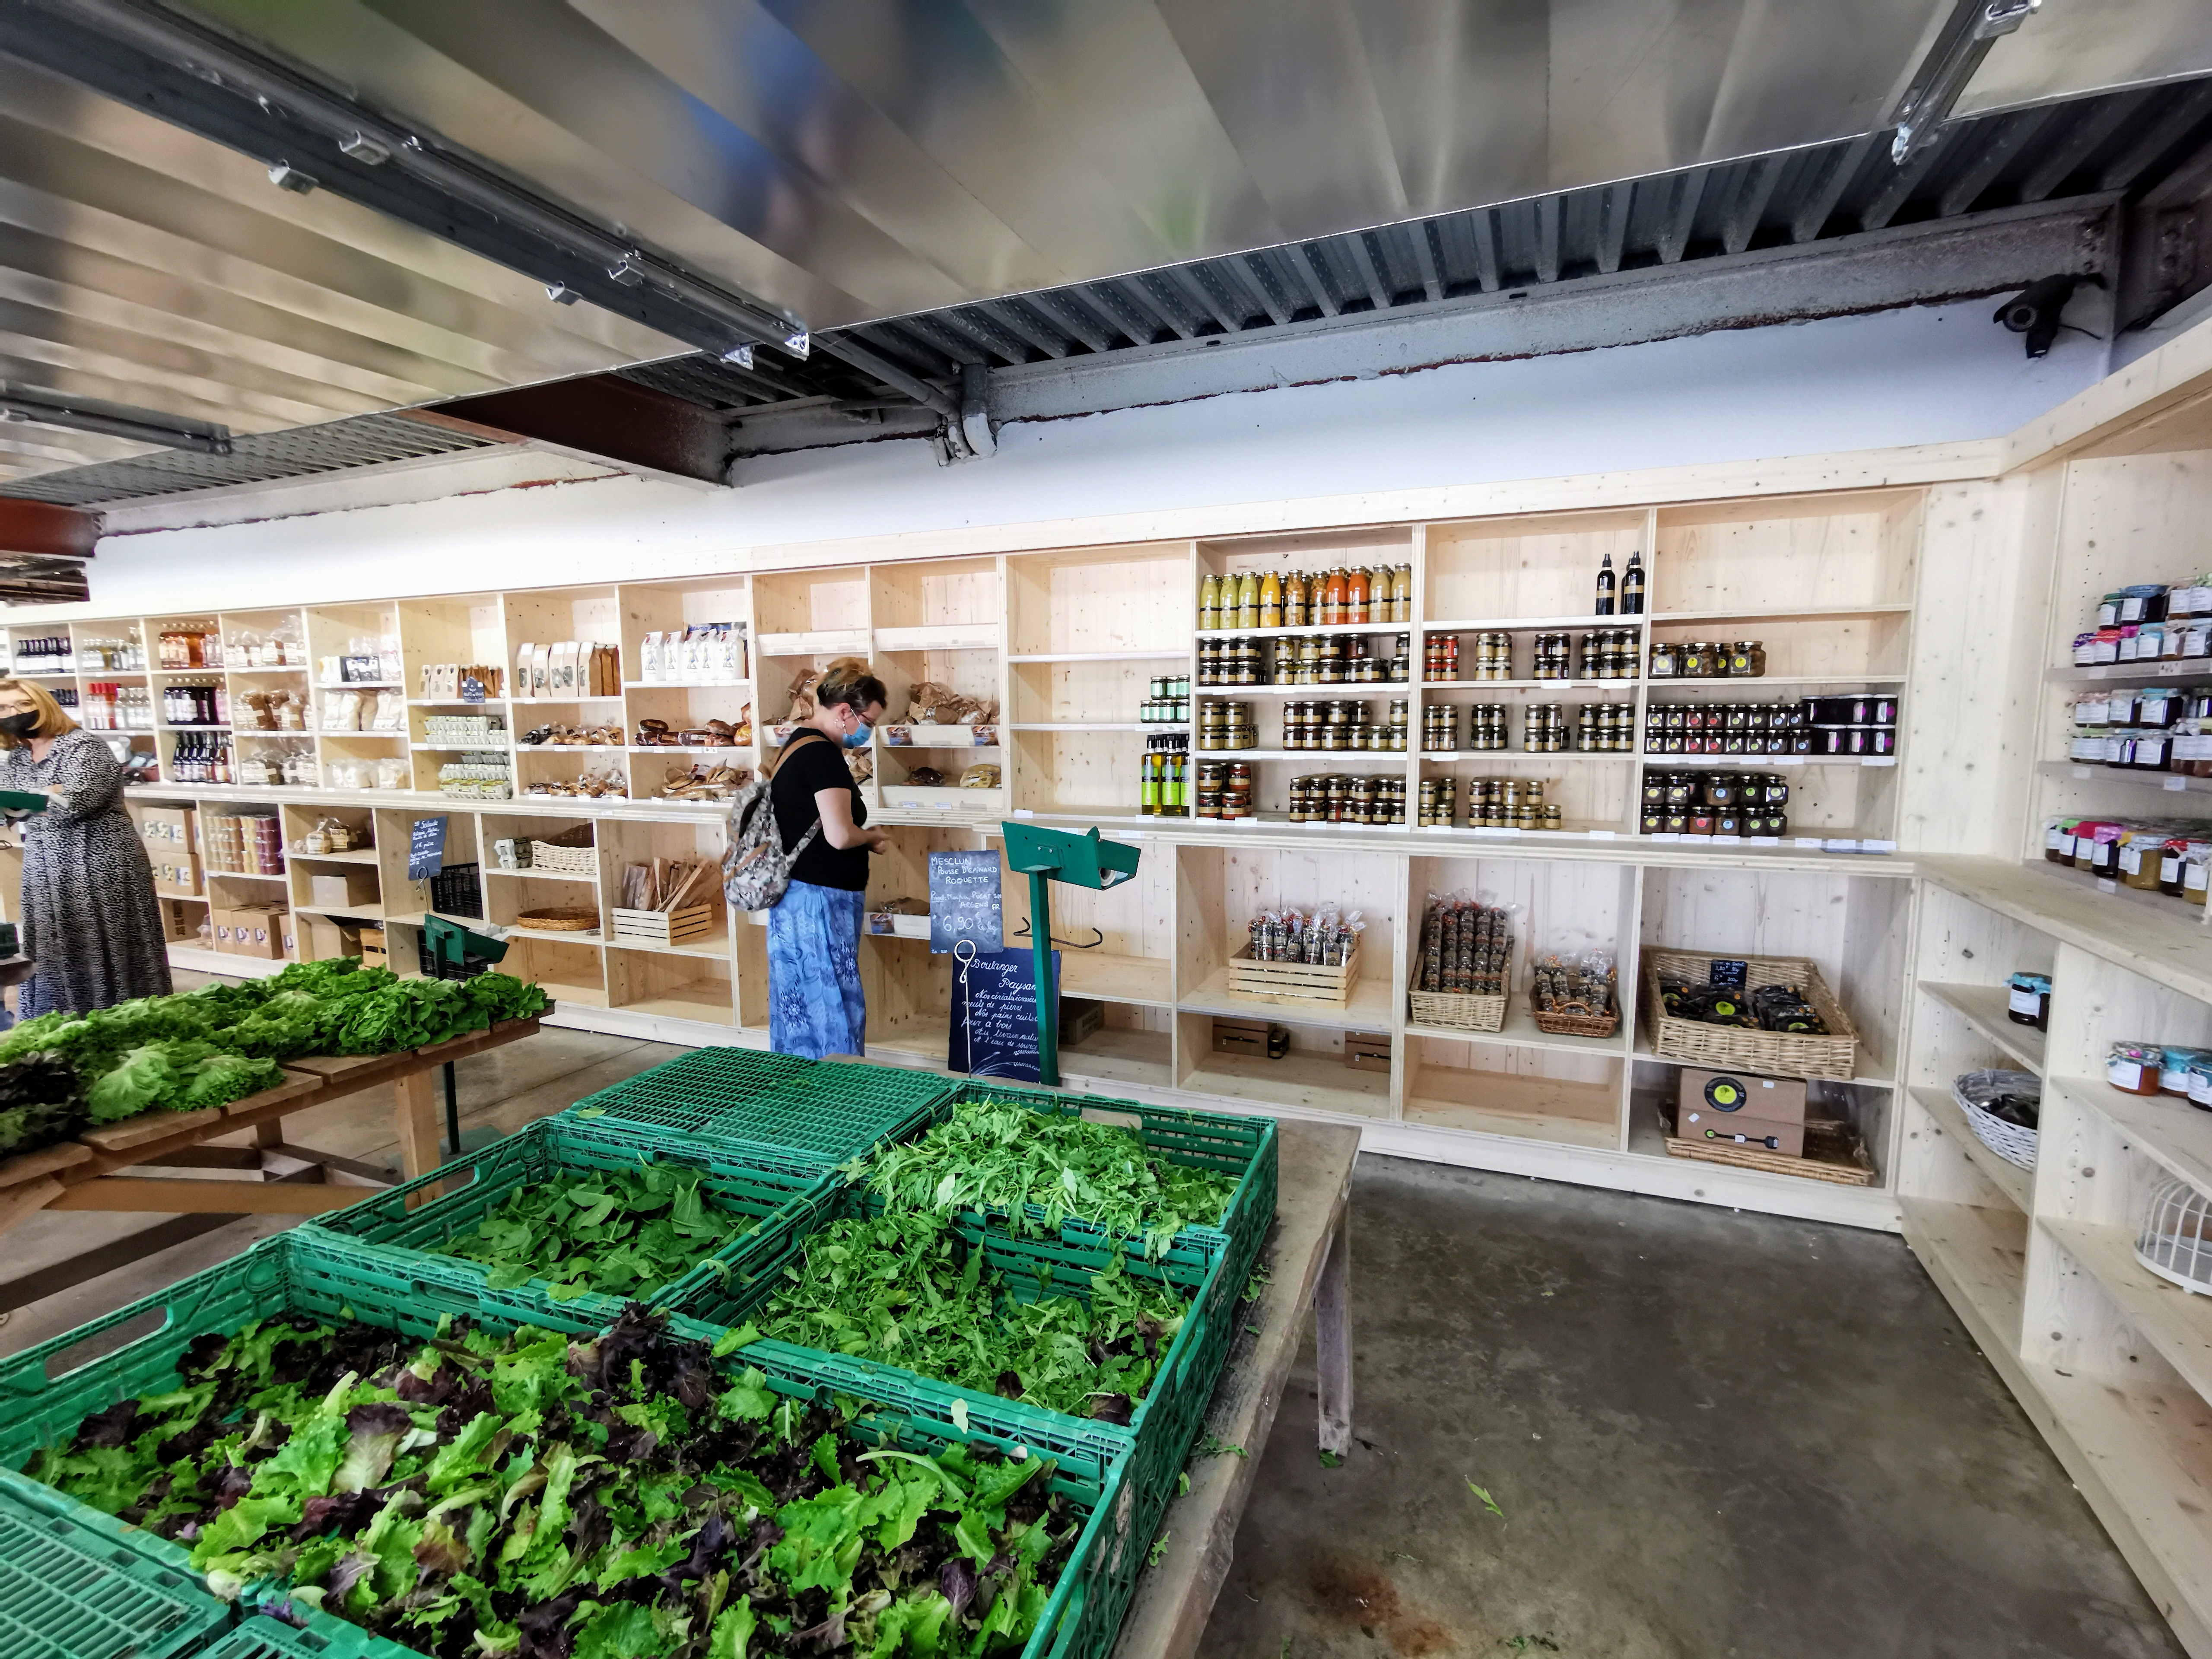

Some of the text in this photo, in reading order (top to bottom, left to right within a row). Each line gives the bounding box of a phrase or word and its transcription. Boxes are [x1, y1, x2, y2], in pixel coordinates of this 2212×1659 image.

[931, 857, 972, 866] MESCLUN
[945, 876, 988, 884] ROQUETTE
[943, 915, 974, 934] 6,90
[970, 958, 1018, 977] Boulanger
[975, 988, 990, 999] Nos
[975, 1007, 988, 1017] Nos
[991, 1011, 1012, 1020] pains
[996, 1020, 1012, 1030] bois
